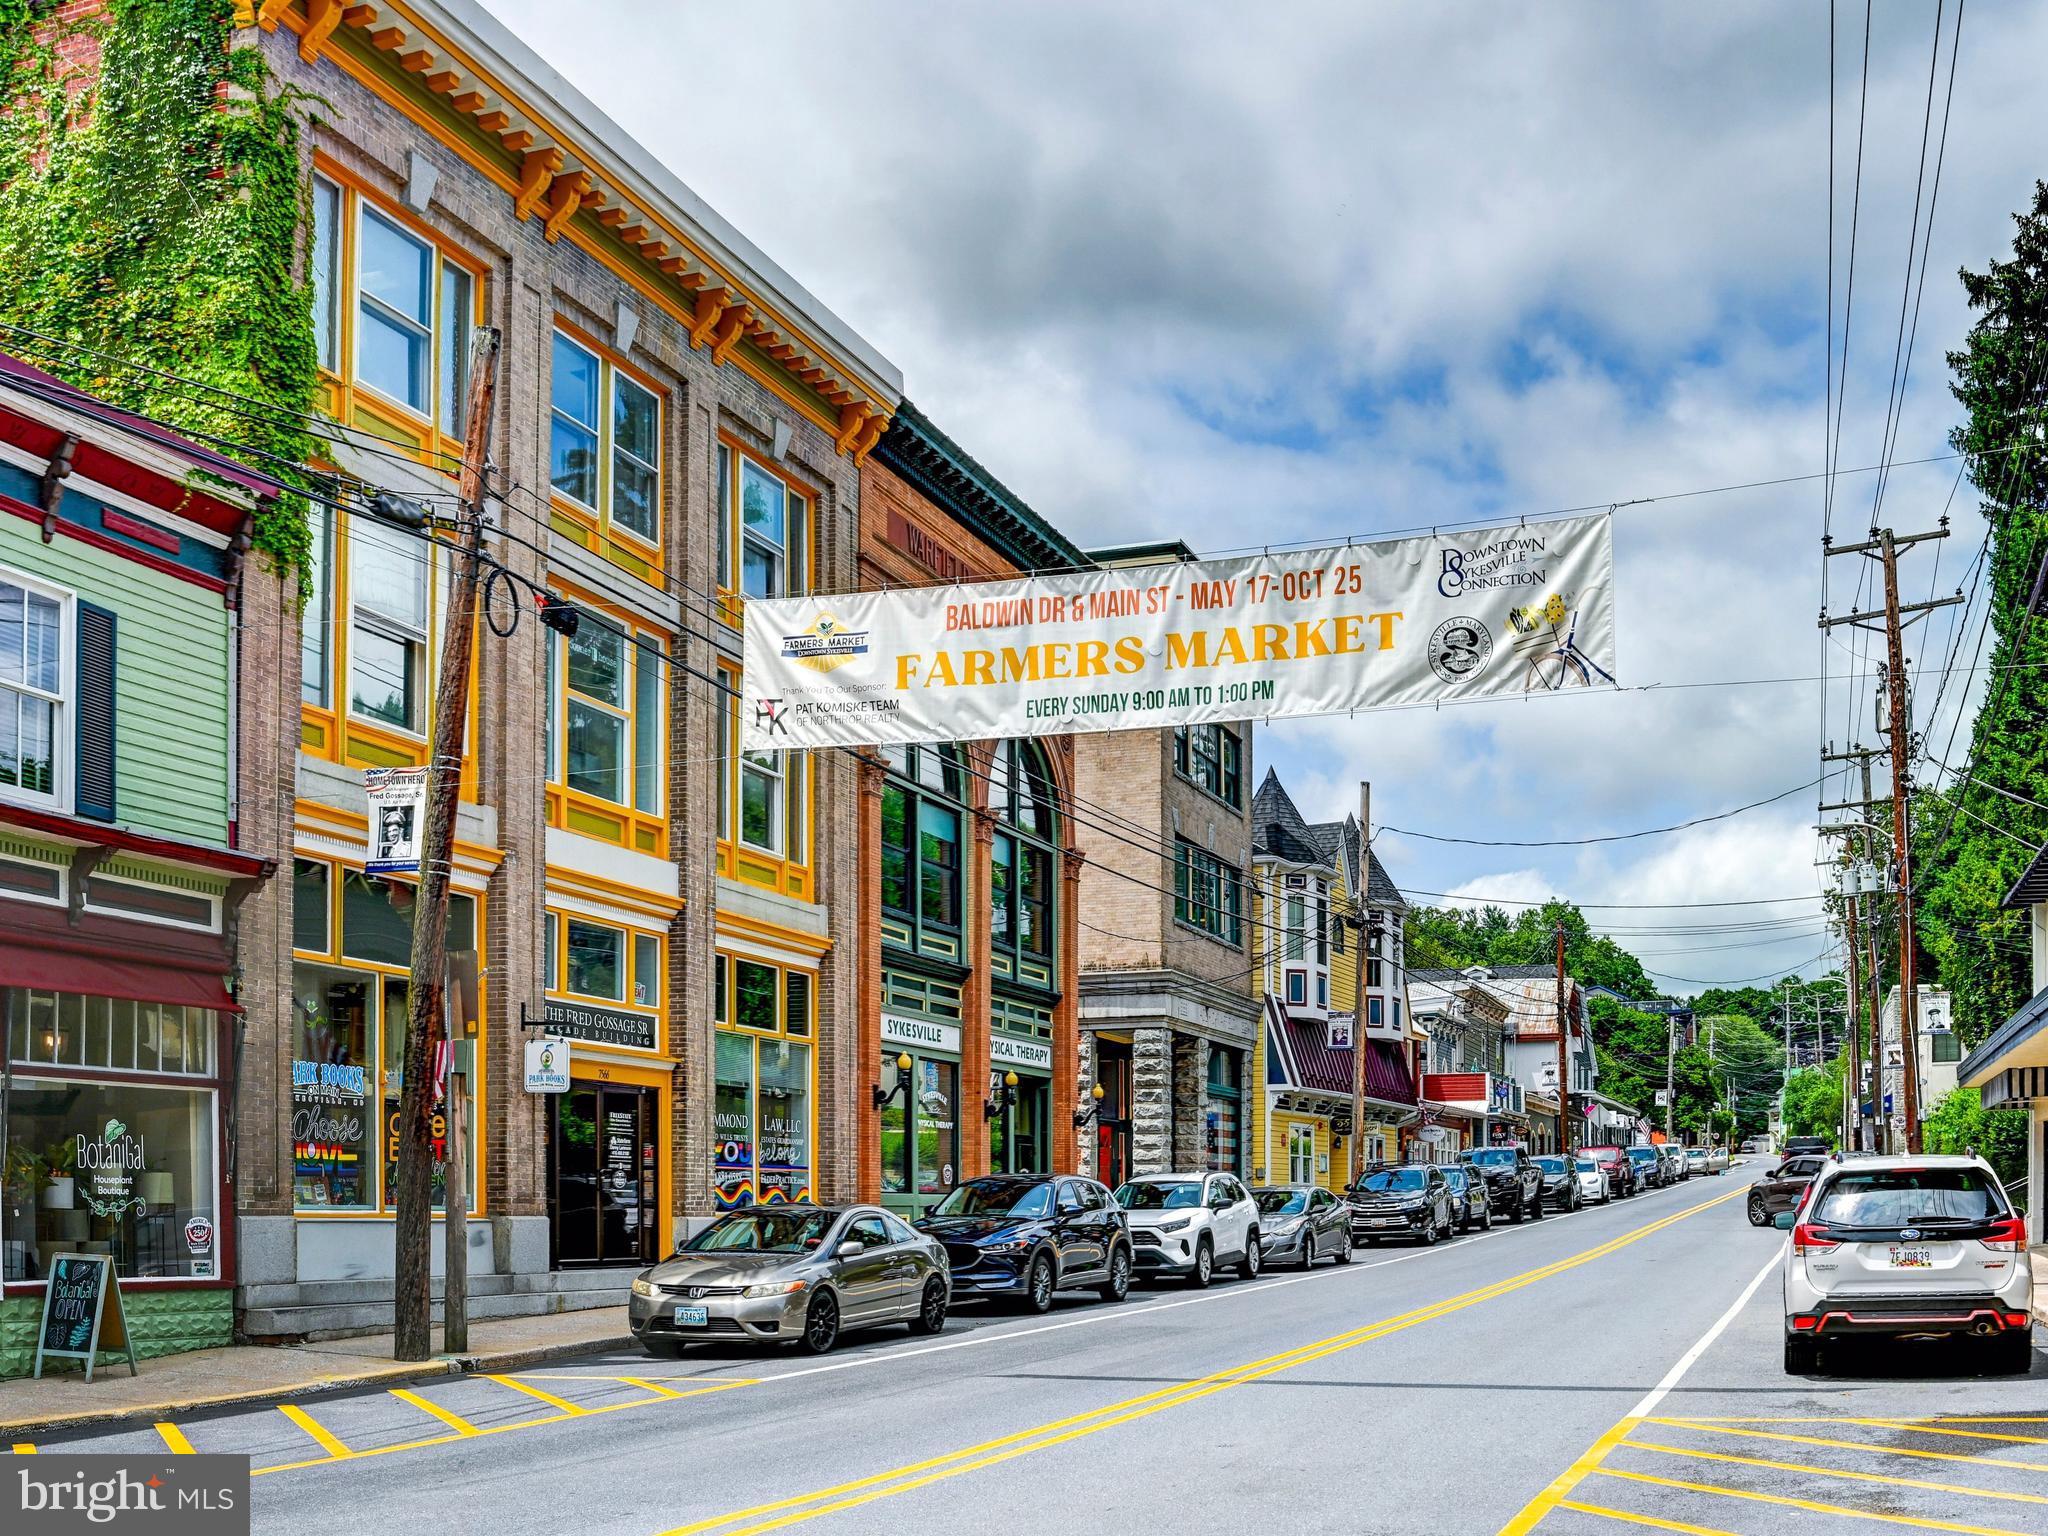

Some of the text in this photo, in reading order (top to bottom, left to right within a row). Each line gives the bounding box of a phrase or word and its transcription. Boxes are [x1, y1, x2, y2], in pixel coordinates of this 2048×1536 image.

[946, 599, 1033, 632] BALDWIN
[1039, 596, 1065, 623] DR
[1072, 594, 1084, 622] &
[1090, 589, 1140, 620] MAIN
[1146, 585, 1170, 615] ST
[1191, 579, 1237, 610] MAY
[1334, 564, 1362, 596] 25
[784, 636, 866, 650] FARMERS MARKET
[895, 611, 1404, 690] FARMERS MARKET
[783, 683, 887, 695] Thank You To Our Sponsor:
[796, 699, 900, 714] PAT KOMISKE TEAM
[1026, 679, 1274, 718] EVERY SUNDAY 9:00 AM TO 1:00 PM
[797, 712, 900, 727] OF NORTHROP REALTY
[368, 774, 426, 786] HOMETOWN HERO
[369, 792, 384, 800] Fred
[545, 1005, 648, 1035] THE FRED GOSSAGE SR
[547, 1024, 650, 1046] RCADE BUILDING
[888, 1019, 942, 1043] SYKESVILLE
[990, 1039, 1048, 1063] YSICAL THERAPY
[293, 1061, 364, 1094] ARK BOOKS
[529, 1075, 565, 1084] PARK BOOKS
[598, 1069, 609, 1079] 7566
[295, 1095, 347, 1106] KESVILLE,
[307, 1085, 340, 1098] ON MAIN
[293, 1104, 363, 1143] Choose
[714, 1113, 801, 1134] MMOND LAW, LLC
[918, 1119, 954, 1130] HYSICAL THERAPY
[77, 1134, 146, 1170] BotaniGal
[759, 1143, 801, 1165] belong
[93, 1174, 133, 1186] Houseplant
[97, 1186, 130, 1197] Boutique
[54, 1299, 86, 1320] OPEN
